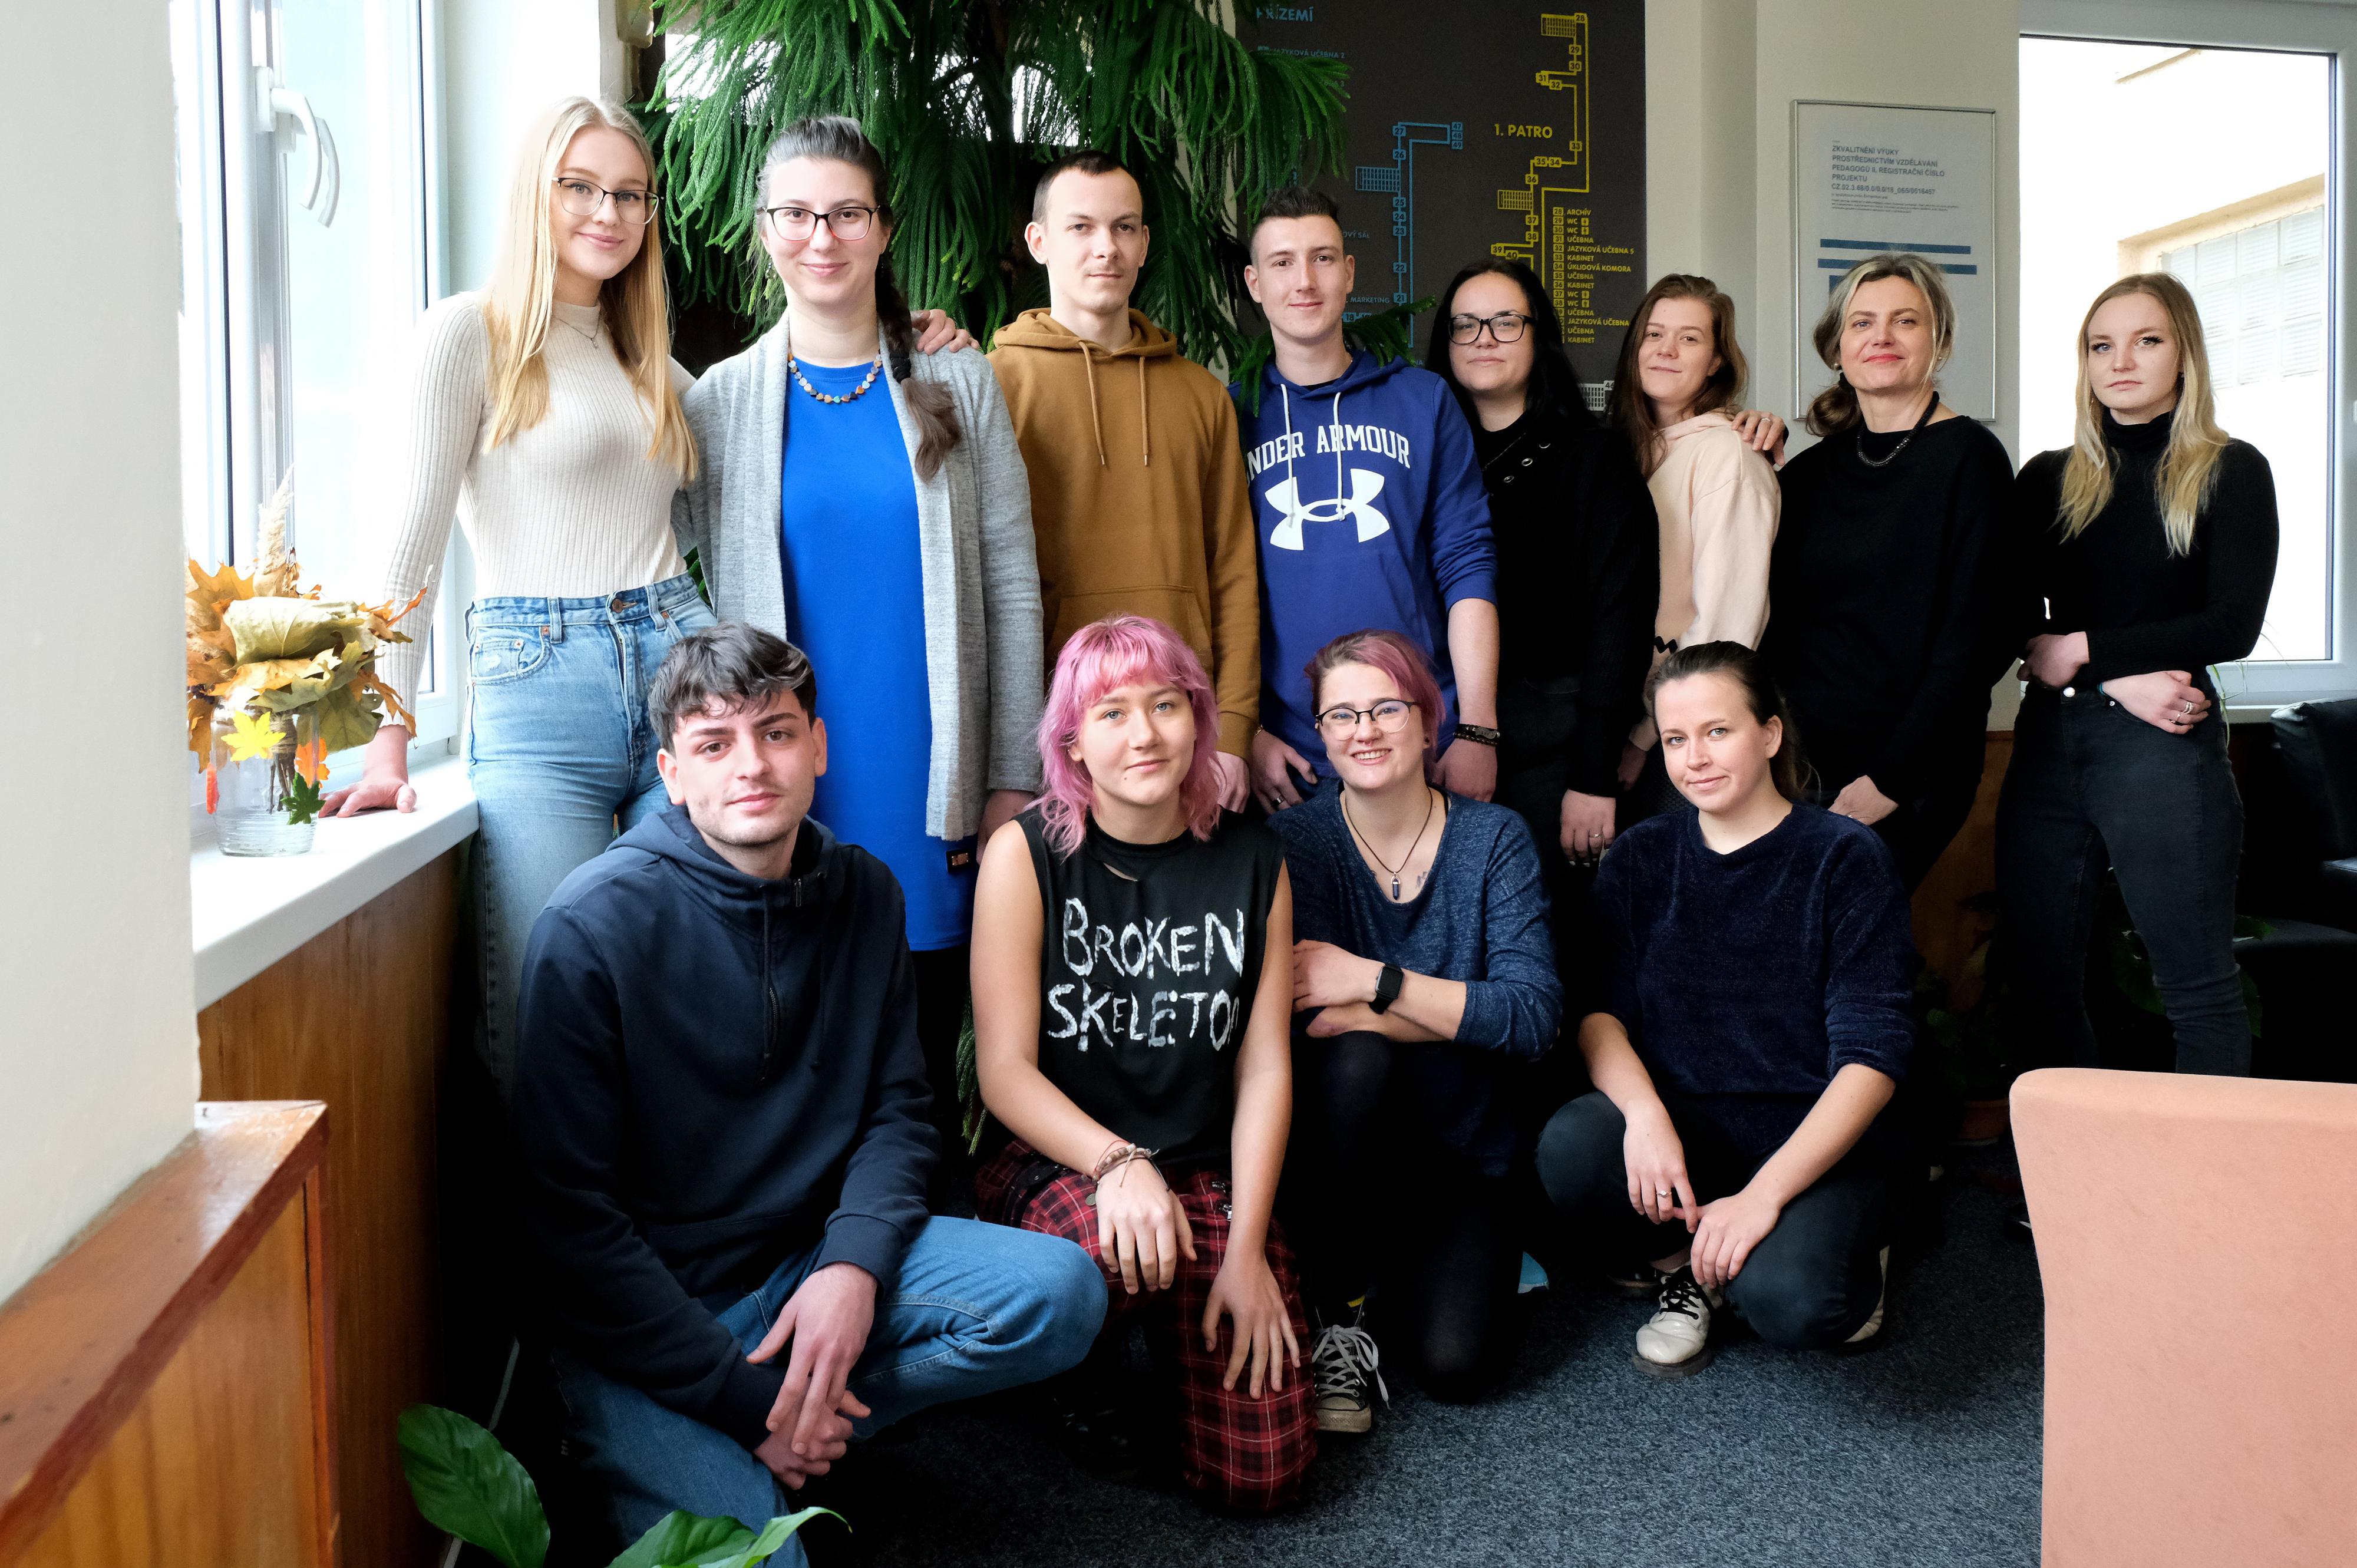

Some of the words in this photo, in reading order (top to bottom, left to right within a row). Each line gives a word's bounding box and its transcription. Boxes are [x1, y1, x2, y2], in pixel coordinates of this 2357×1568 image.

[1494, 123, 1504, 136] 1.
[1508, 124, 1553, 139] PATRO
[1832, 174, 1867, 182] PROJEKTU
[1567, 235, 1594, 243] UČEBNA
[1567, 245, 1601, 253] JAZYKOVÁ
[1602, 245, 1629, 254] UČEBNA
[1567, 262, 1600, 270] ÚKLIDOVÁ
[1567, 272, 1594, 280] UČEBNA
[1567, 308, 1595, 316] UČEBNA
[1568, 318, 1602, 326] JAZYKOVÁ
[1603, 318, 1629, 326] UČEBNA
[1567, 326, 1595, 335] UČEBNA
[1246, 431, 1305, 481] NDER
[1316, 424, 1411, 469] ARMOUR
[1063, 897, 1244, 980] BROKEN
